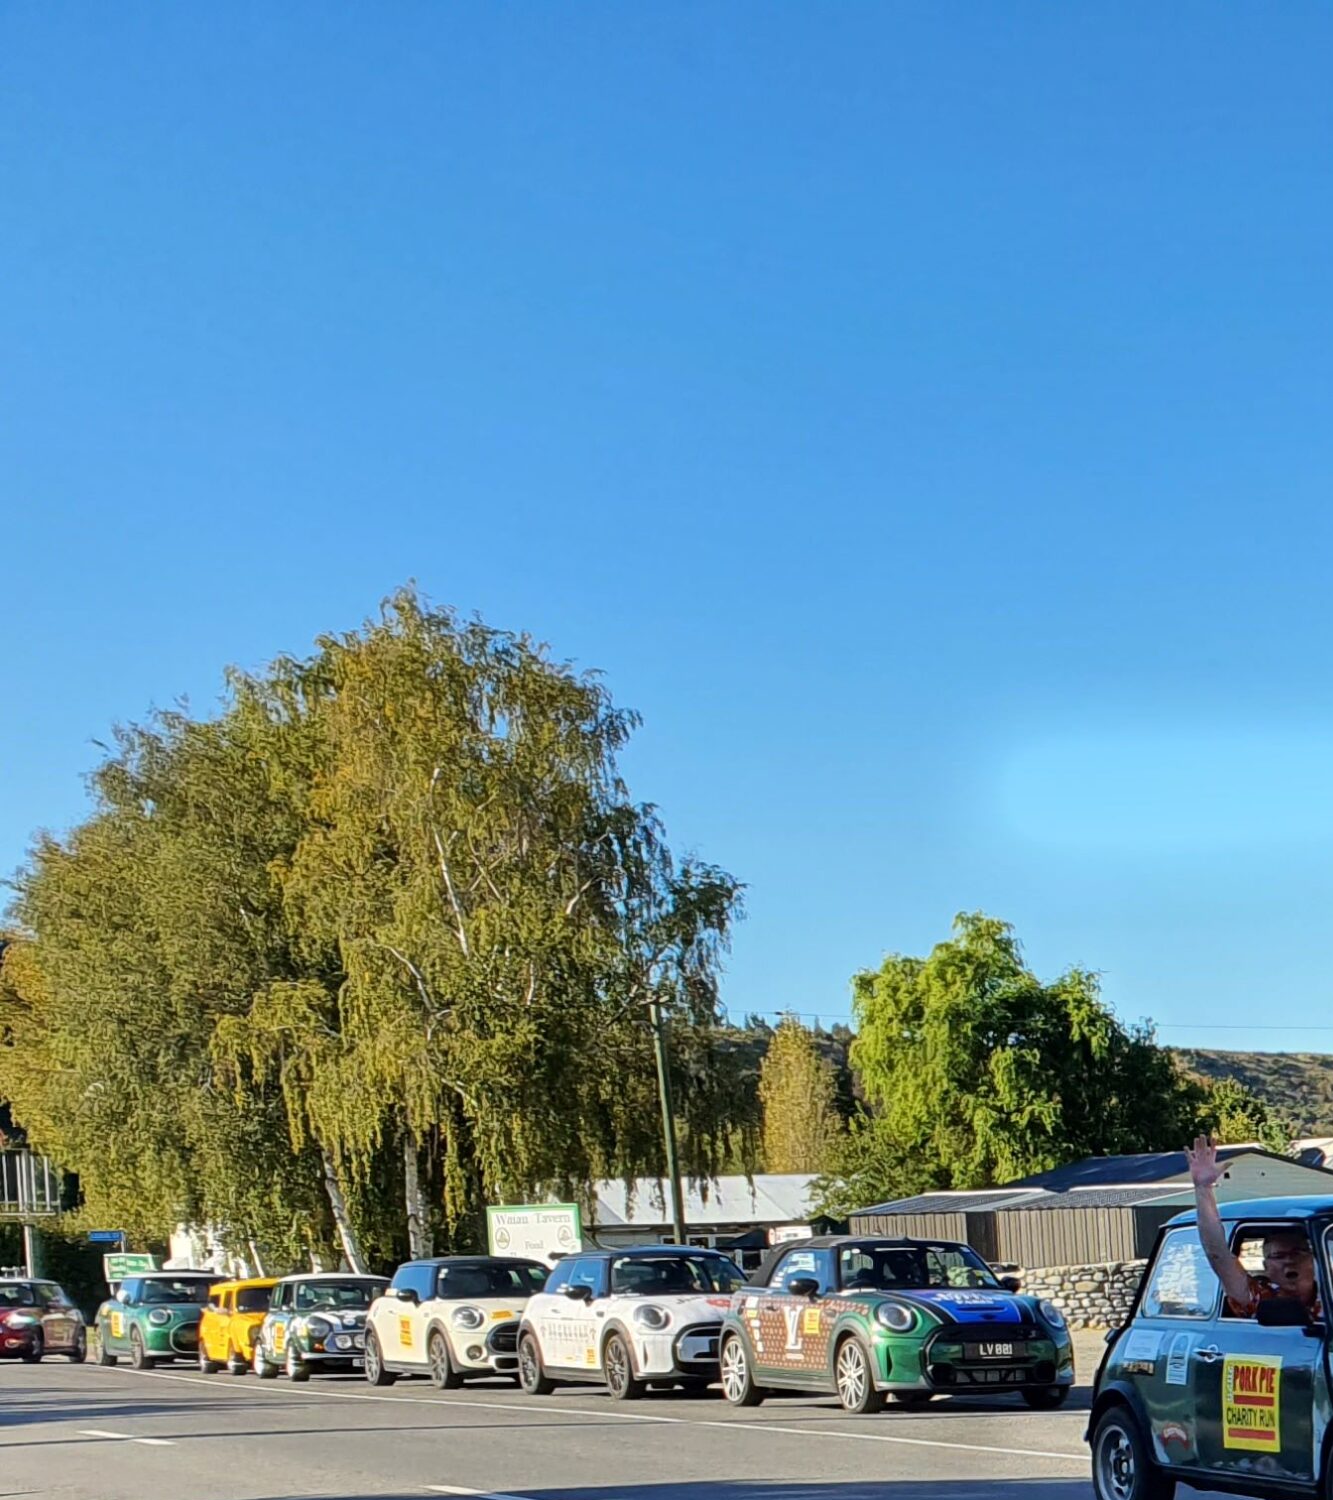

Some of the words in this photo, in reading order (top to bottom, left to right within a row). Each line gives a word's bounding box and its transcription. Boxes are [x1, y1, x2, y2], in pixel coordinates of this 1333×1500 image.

[1234, 1364, 1258, 1392] PORK
[1260, 1366, 1276, 1394] PIE
[1226, 1407, 1258, 1427] CHARITY
[1260, 1409, 1276, 1428] RUN
